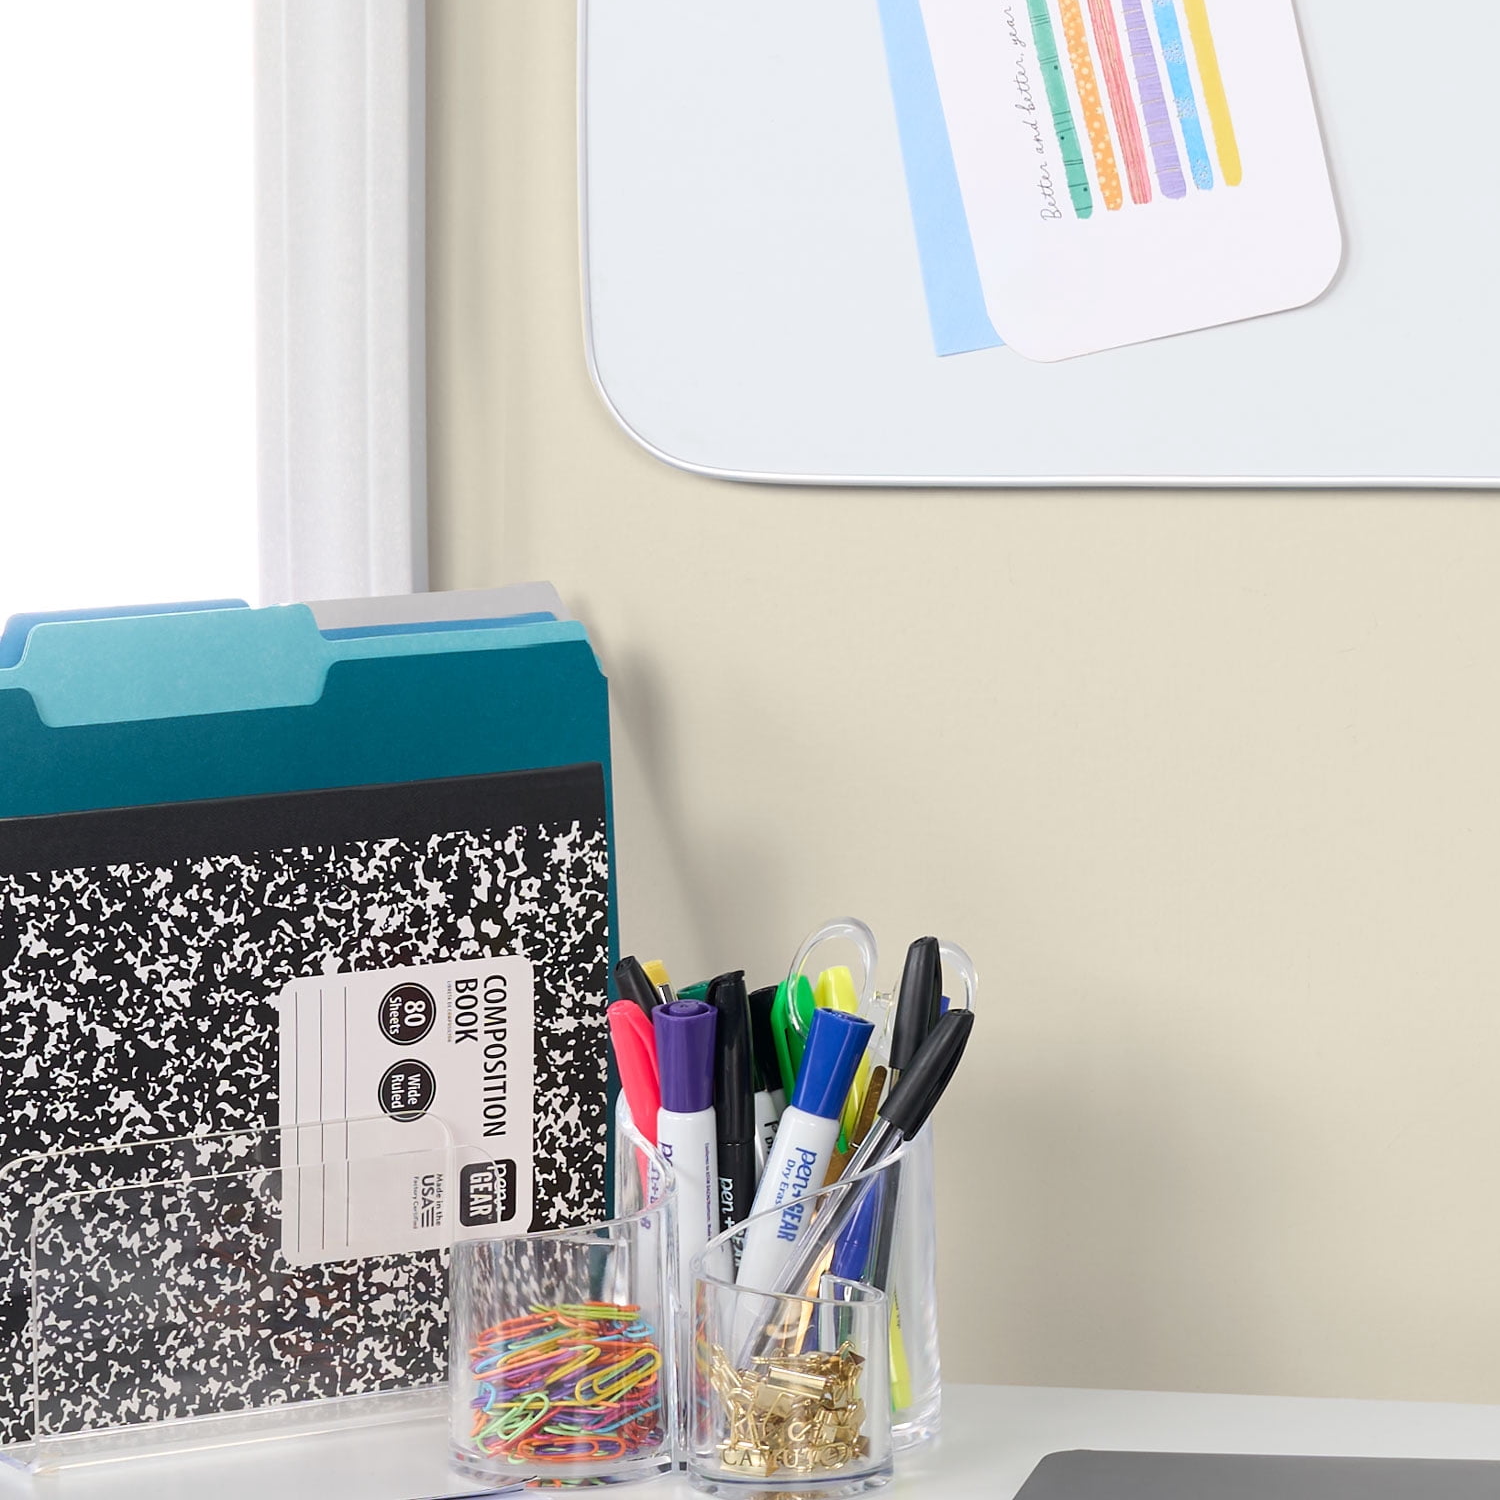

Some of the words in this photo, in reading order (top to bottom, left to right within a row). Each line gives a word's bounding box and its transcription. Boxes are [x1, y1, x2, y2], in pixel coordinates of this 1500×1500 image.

[1006, 6, 1026, 47] year
[1015, 52, 1037, 113] better,
[1023, 120, 1045, 154] and
[1037, 161, 1064, 220] Better
[389, 996, 403, 1035] Sheets
[404, 1000, 426, 1028] 80
[454, 978, 479, 1044] BOOK
[482, 974, 507, 1137] COMPOSITION
[391, 1073, 405, 1109] Ruled
[407, 1073, 421, 1105] Wide
[436, 1173, 444, 1199] Made
[782, 1159, 796, 1179] Dry
[412, 1175, 420, 1200] Factory
[421, 1174, 435, 1209] USA
[436, 1200, 443, 1210] in
[469, 1171, 494, 1218] GEAR
[775, 1181, 789, 1206] Eras
